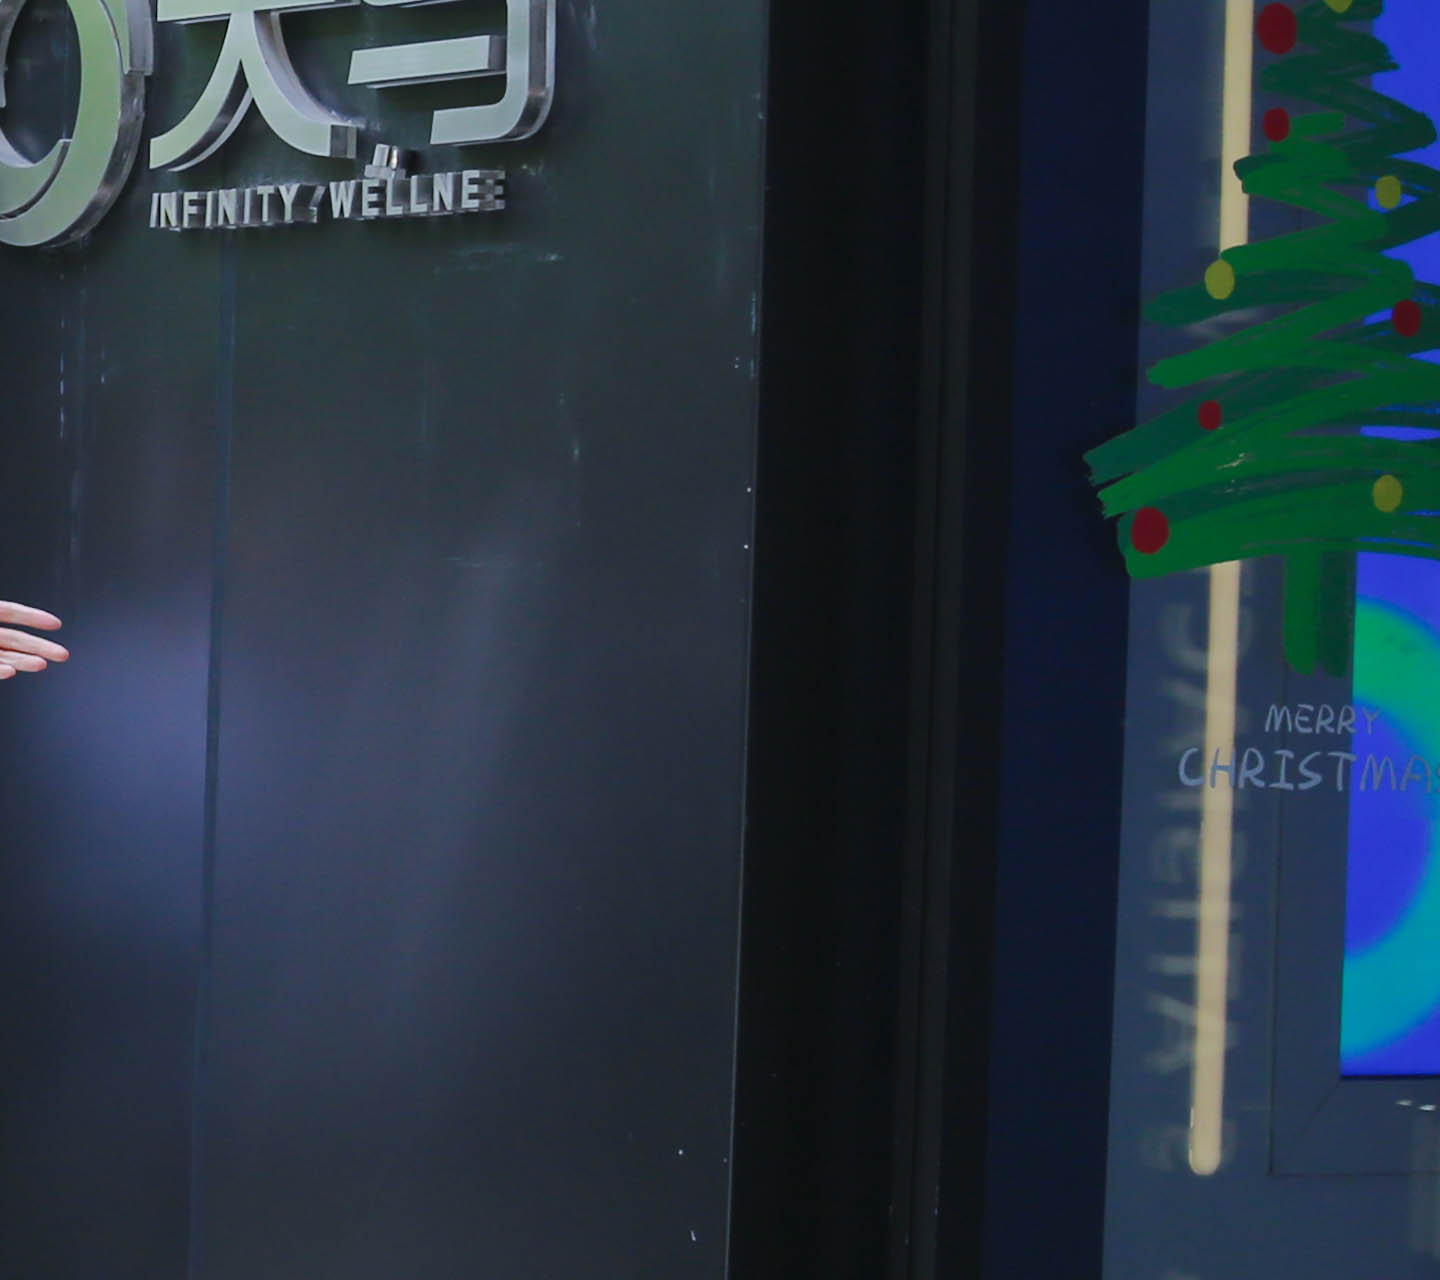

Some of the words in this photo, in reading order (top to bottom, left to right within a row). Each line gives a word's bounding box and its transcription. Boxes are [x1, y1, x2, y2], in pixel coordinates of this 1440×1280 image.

[149, 183, 301, 229] INFINITY
[1264, 703, 1379, 735] MERRY
[1177, 746, 1440, 793] CHRISTMA
